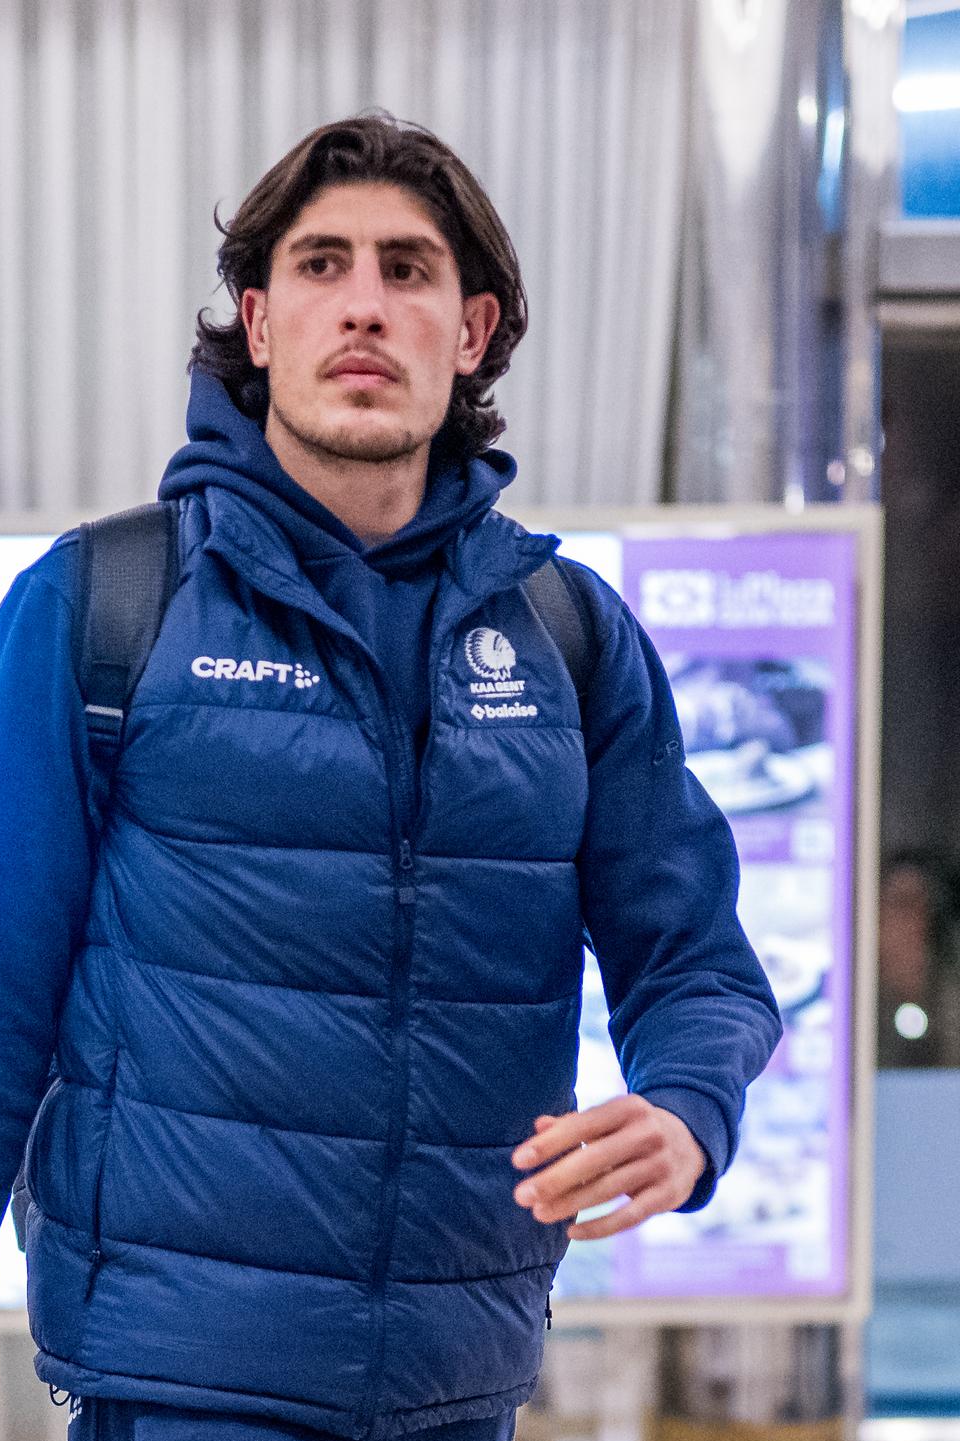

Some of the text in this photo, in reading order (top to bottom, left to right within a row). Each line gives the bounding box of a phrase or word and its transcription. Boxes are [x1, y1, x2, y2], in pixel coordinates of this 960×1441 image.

[191, 656, 292, 683] CRAFT
[470, 680, 525, 694] KAA GENT
[484, 701, 538, 719] baloise
